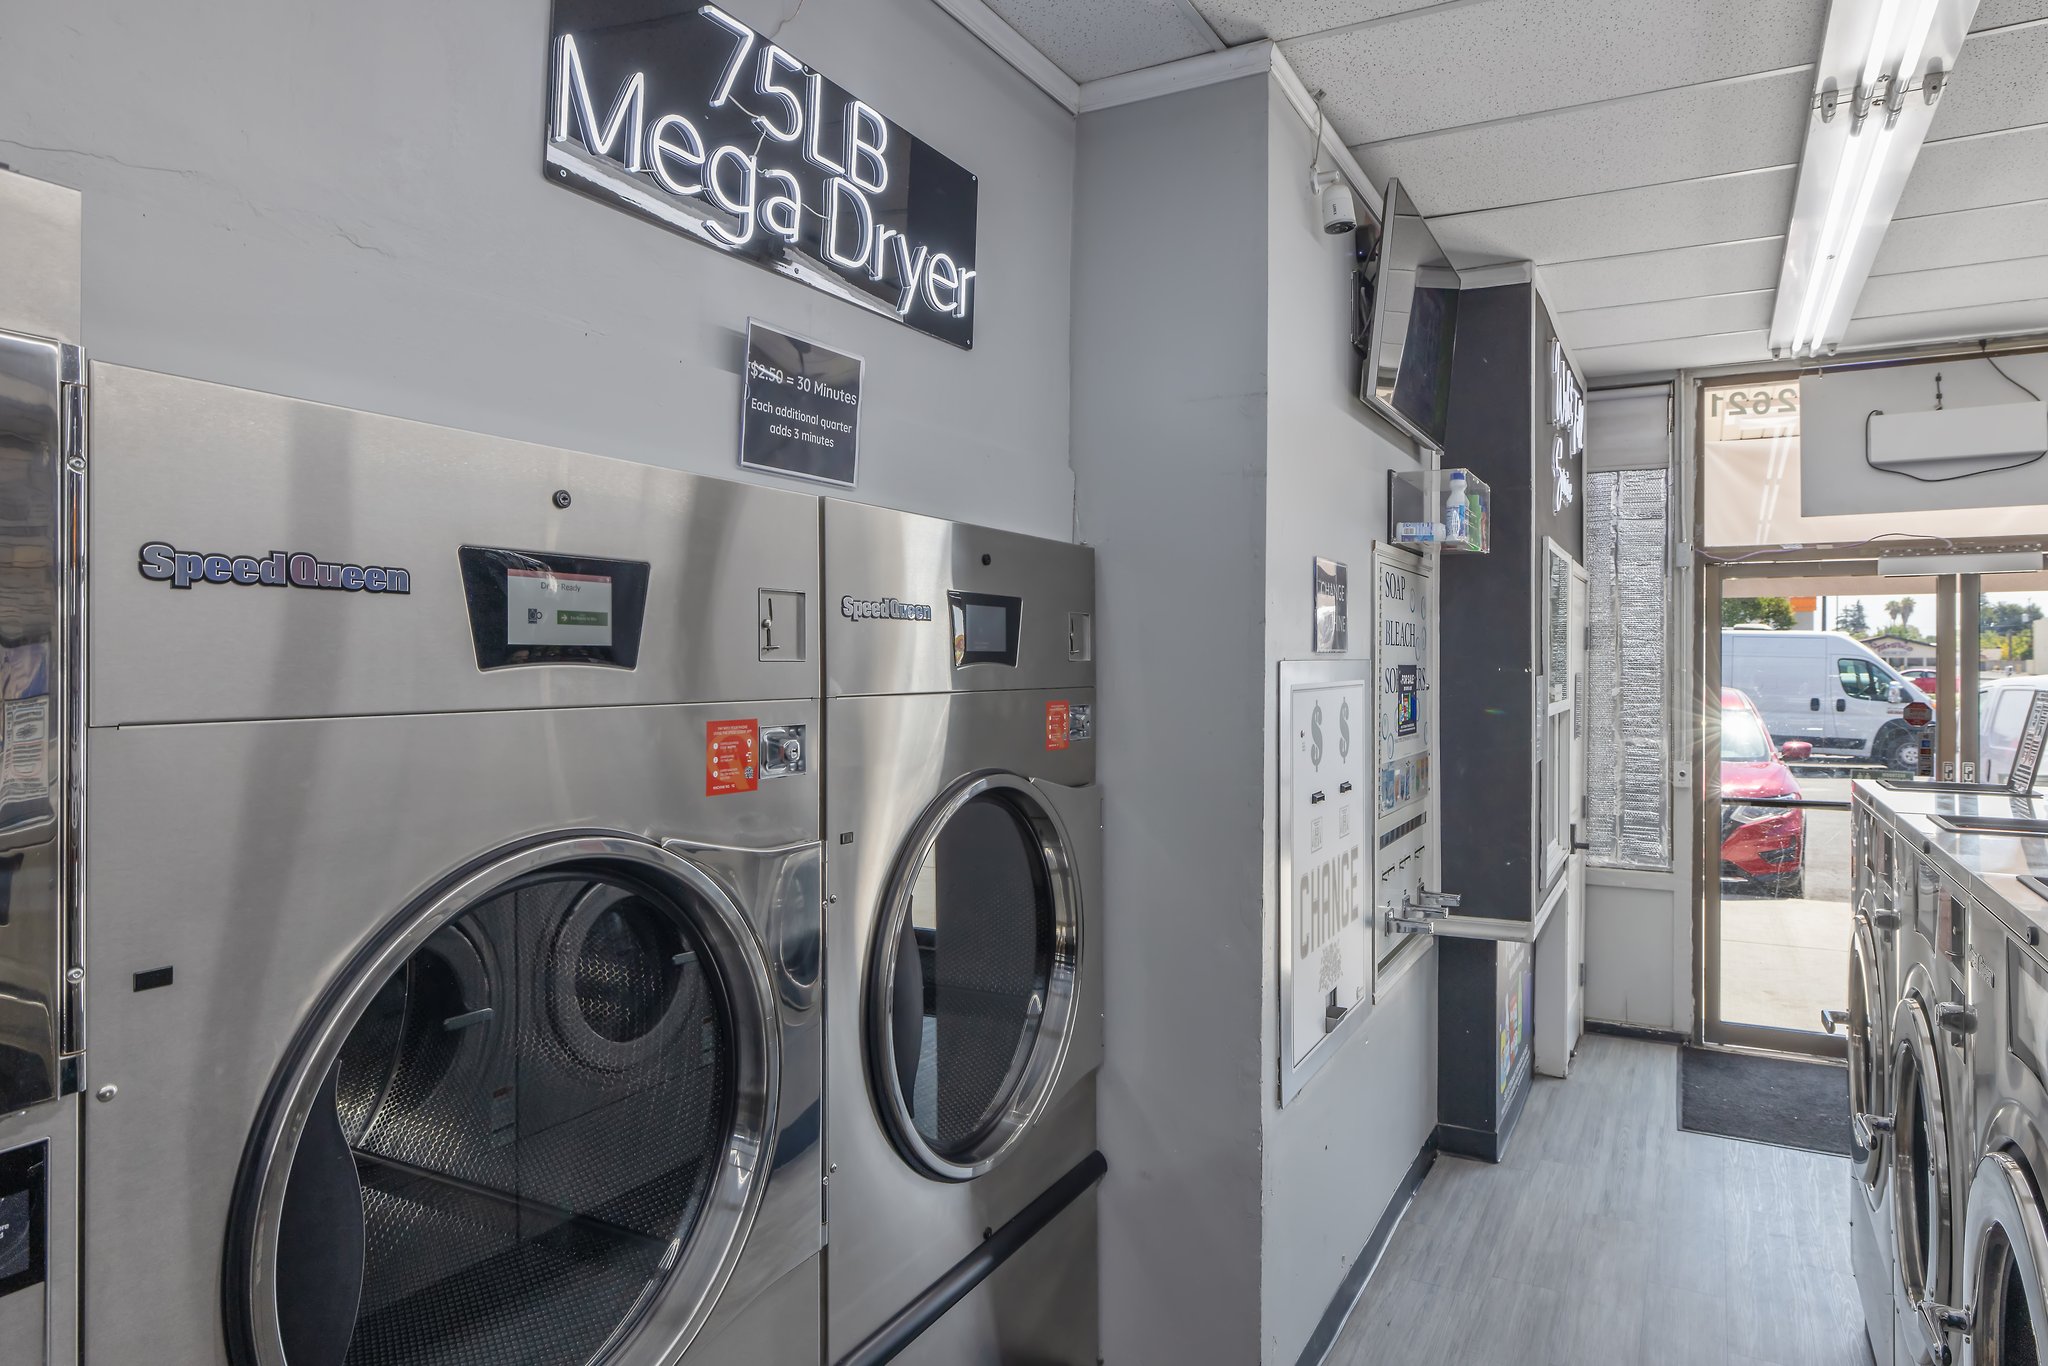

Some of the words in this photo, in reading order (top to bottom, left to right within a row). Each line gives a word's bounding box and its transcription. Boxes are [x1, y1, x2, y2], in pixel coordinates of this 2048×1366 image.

[698, 5, 889, 194] 75LB
[551, 33, 801, 246] Mega
[820, 176, 977, 318] Dryer
[797, 375, 811, 393] 30
[814, 381, 857, 406] Minutes
[751, 397, 773, 414] Each
[775, 406, 819, 426] additional
[820, 418, 853, 434] quarter
[770, 423, 792, 438] adds
[794, 427, 799, 440] 3
[801, 431, 835, 448] minutes
[560, 583, 582, 593] Ready
[1385, 571, 1406, 601] SOAP
[1385, 619, 1416, 648] BLEACH
[1300, 845, 1359, 961] CHANGE
